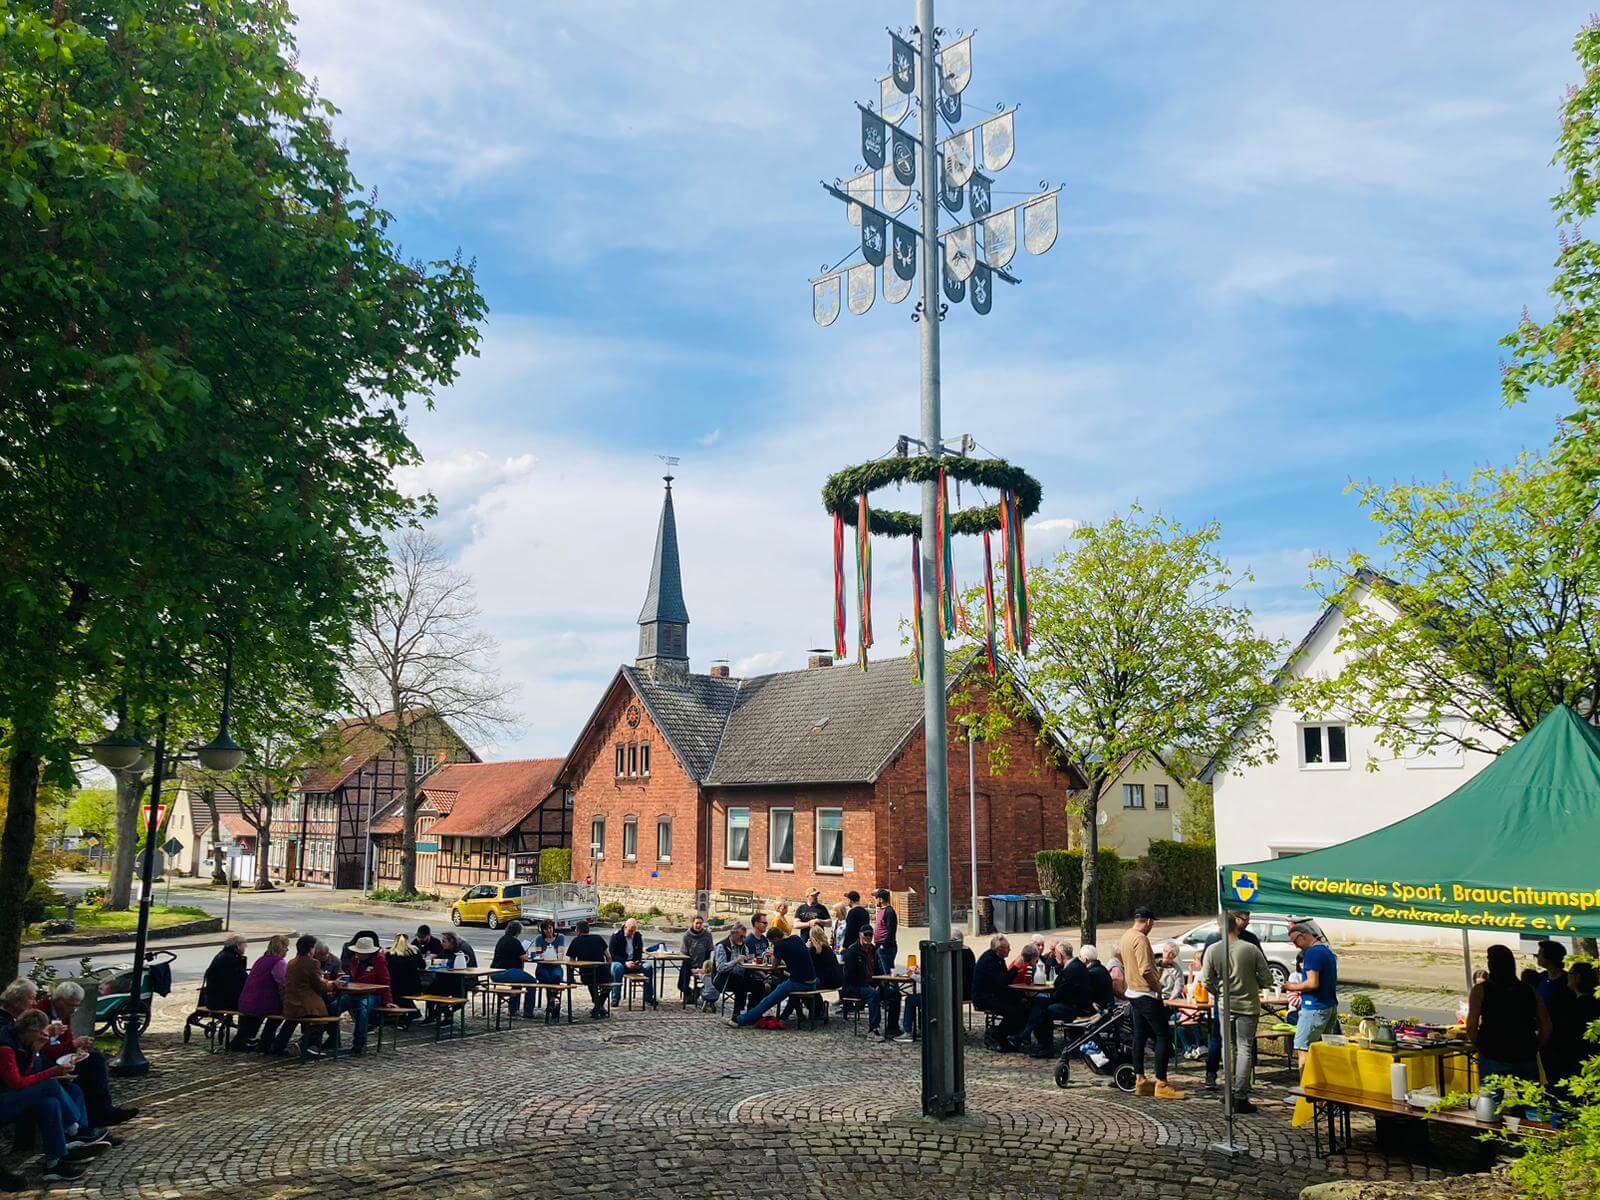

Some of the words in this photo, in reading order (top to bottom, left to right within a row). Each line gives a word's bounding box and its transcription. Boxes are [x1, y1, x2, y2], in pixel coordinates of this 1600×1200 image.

[1291, 875, 1387, 897] Förderkreis
[1392, 881, 1447, 903] Sport,
[1349, 904, 1365, 917] u.
[1371, 903, 1527, 928] Denkmalschutz
[1531, 914, 1577, 932] e.V.
